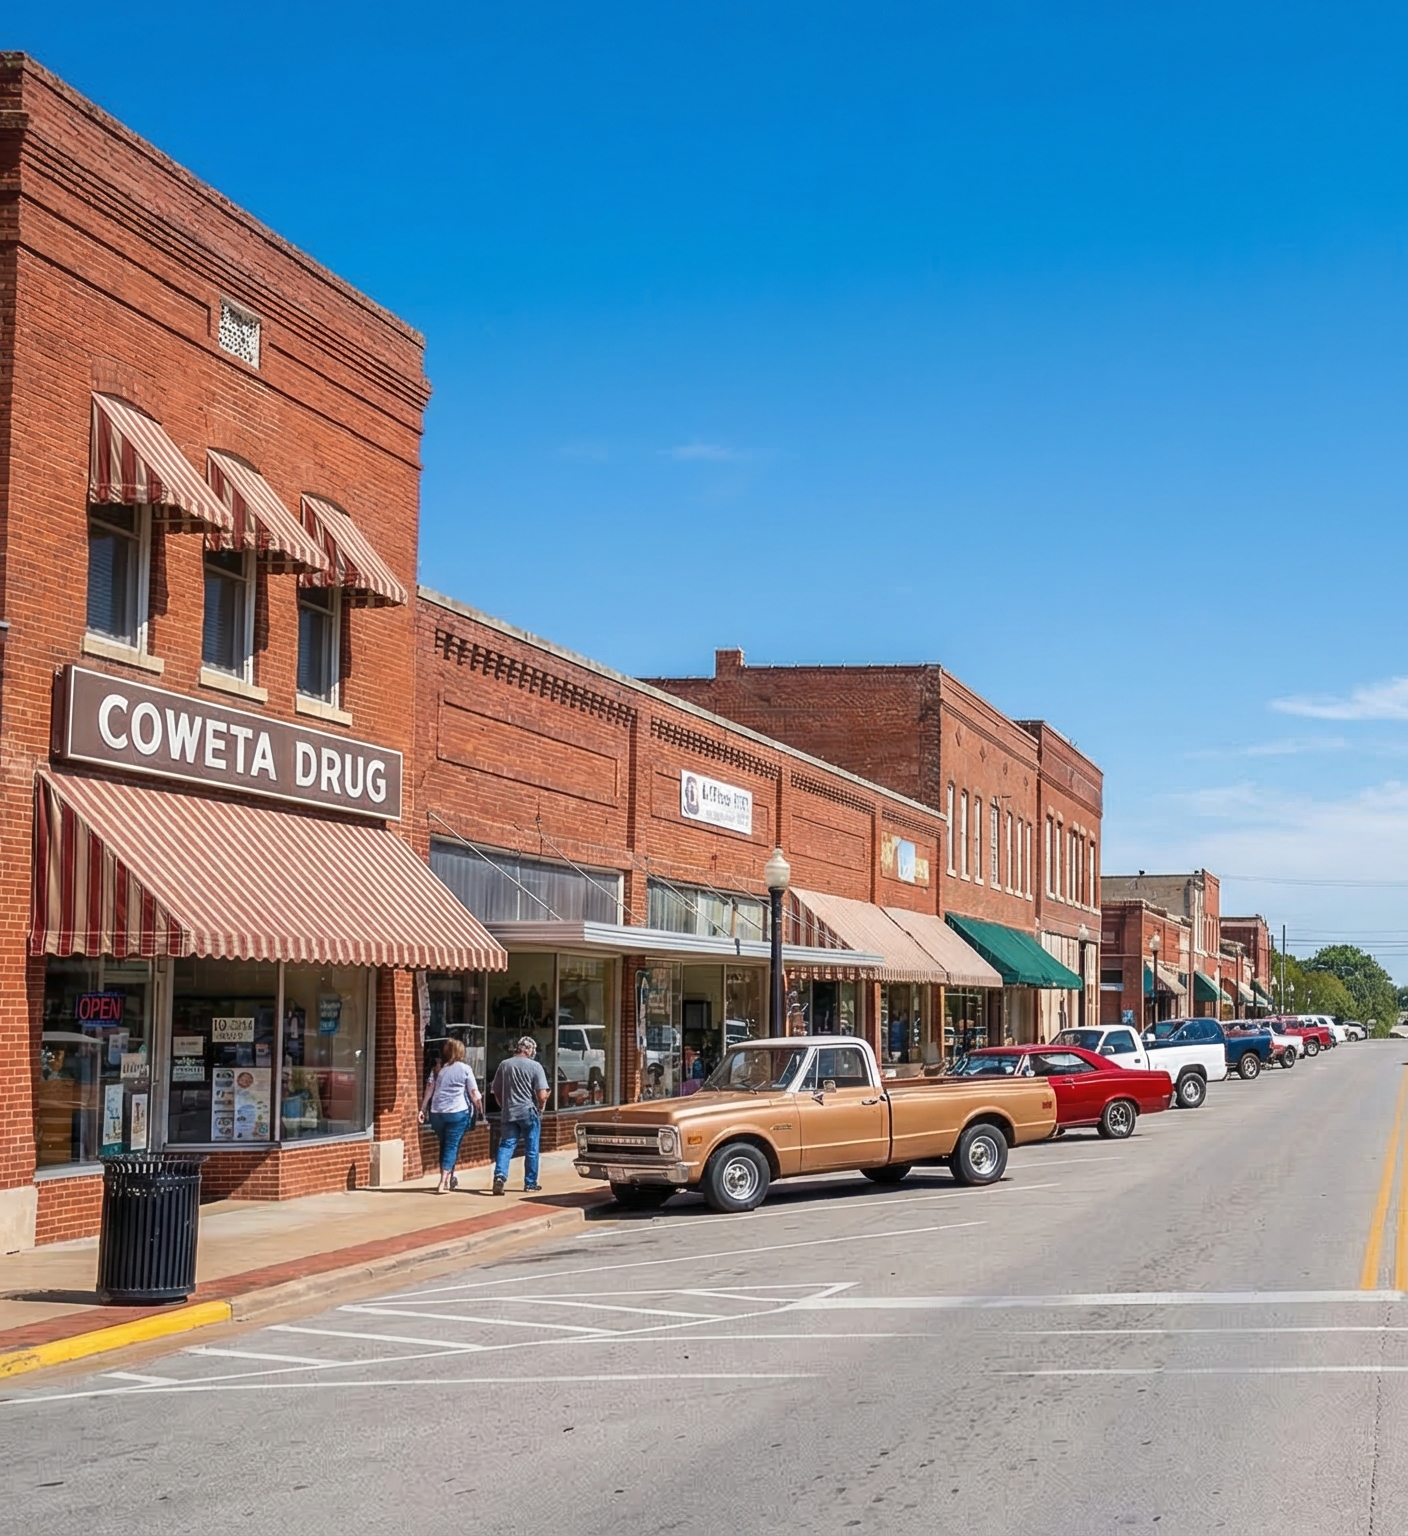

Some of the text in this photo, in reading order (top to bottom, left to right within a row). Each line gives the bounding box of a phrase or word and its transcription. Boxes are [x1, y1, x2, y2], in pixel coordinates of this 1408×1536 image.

[98, 694, 387, 804] COWETA DRUG
[79, 997, 121, 1020] OPEN
